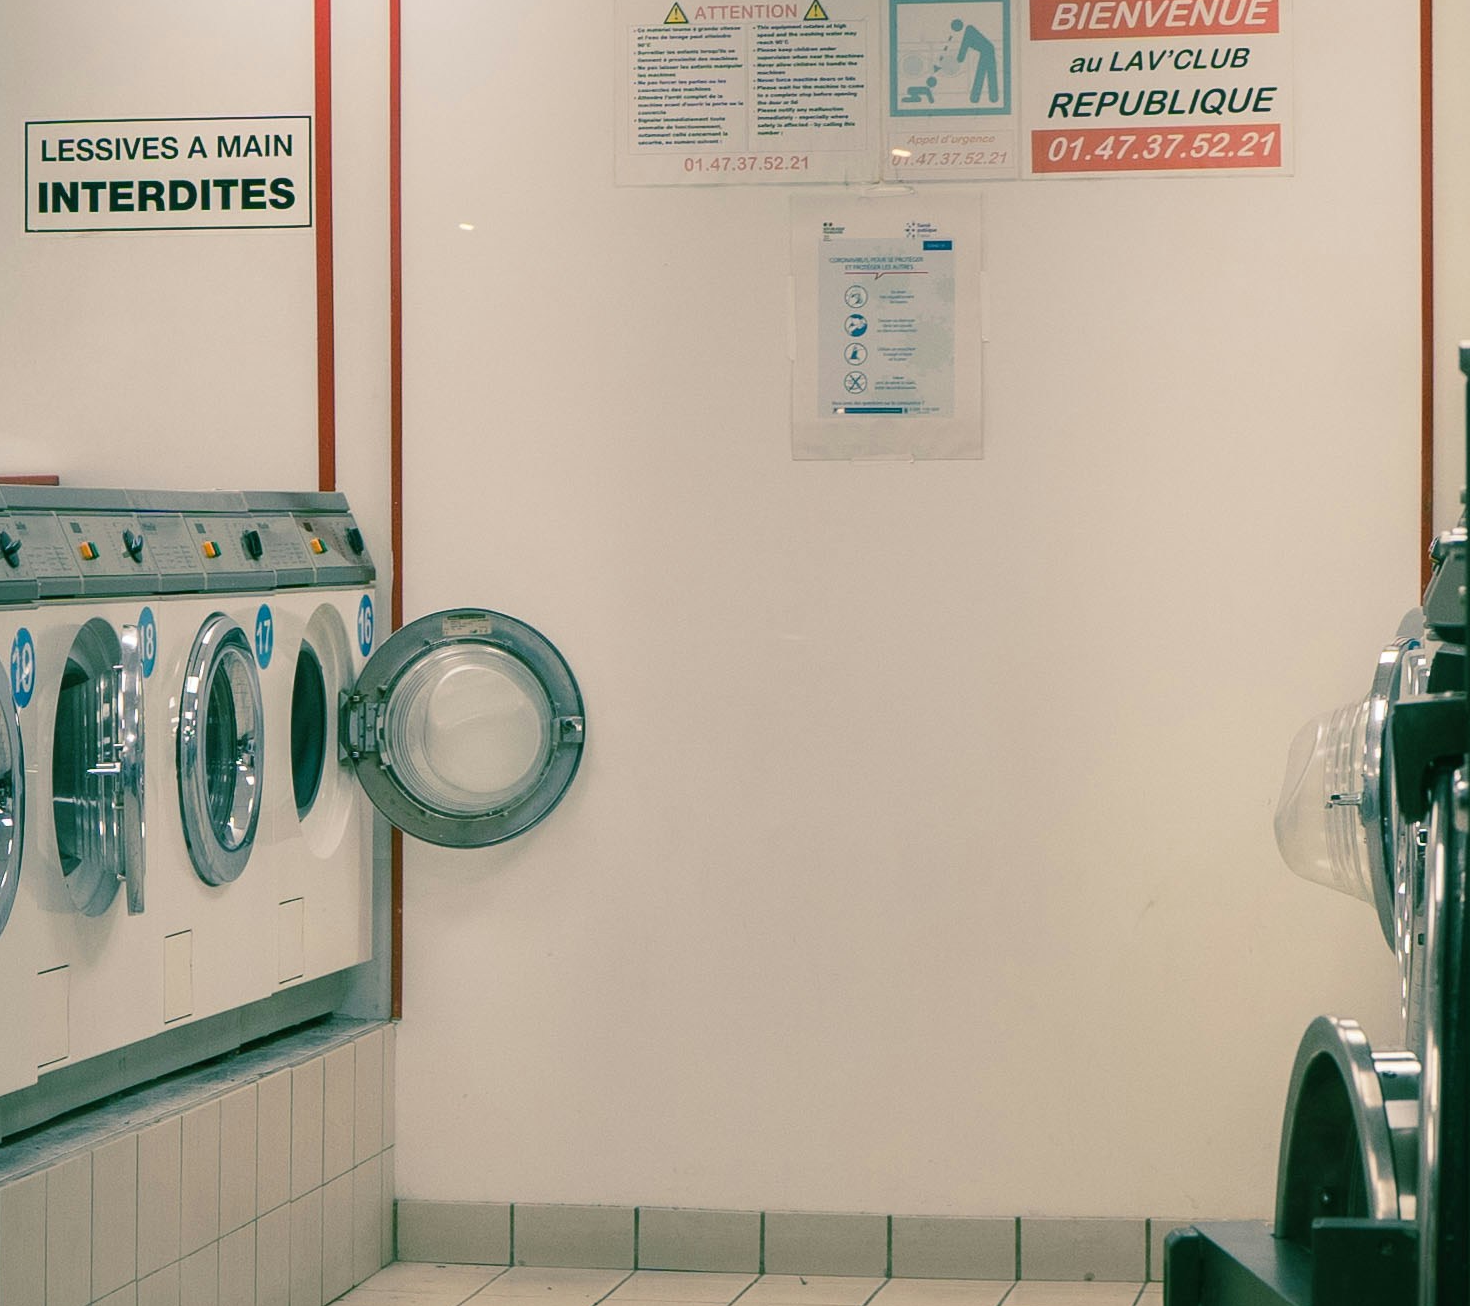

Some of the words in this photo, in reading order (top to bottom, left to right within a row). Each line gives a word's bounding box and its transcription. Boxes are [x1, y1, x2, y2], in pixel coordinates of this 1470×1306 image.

[694, 3, 798, 21] ATTENTION
[1069, 56, 1103, 73] au
[1109, 47, 1250, 72] LAV'CLUB
[1047, 86, 1278, 118] REPUBLIQUE
[41, 136, 179, 162] LESSIVES
[187, 136, 208, 159] A
[216, 134, 293, 158] MAIN
[907, 134, 939, 146] Appel
[941, 134, 996, 146] d'urgence
[1047, 131, 1275, 162] 01.47.37.52.21
[684, 156, 809, 172] 01.47.37.52.21
[38, 177, 296, 214] INTERDITES
[140, 622, 153, 652] 18
[256, 619, 272, 655] 17
[361, 612, 372, 641] 16
[13, 642, 32, 693] 19
